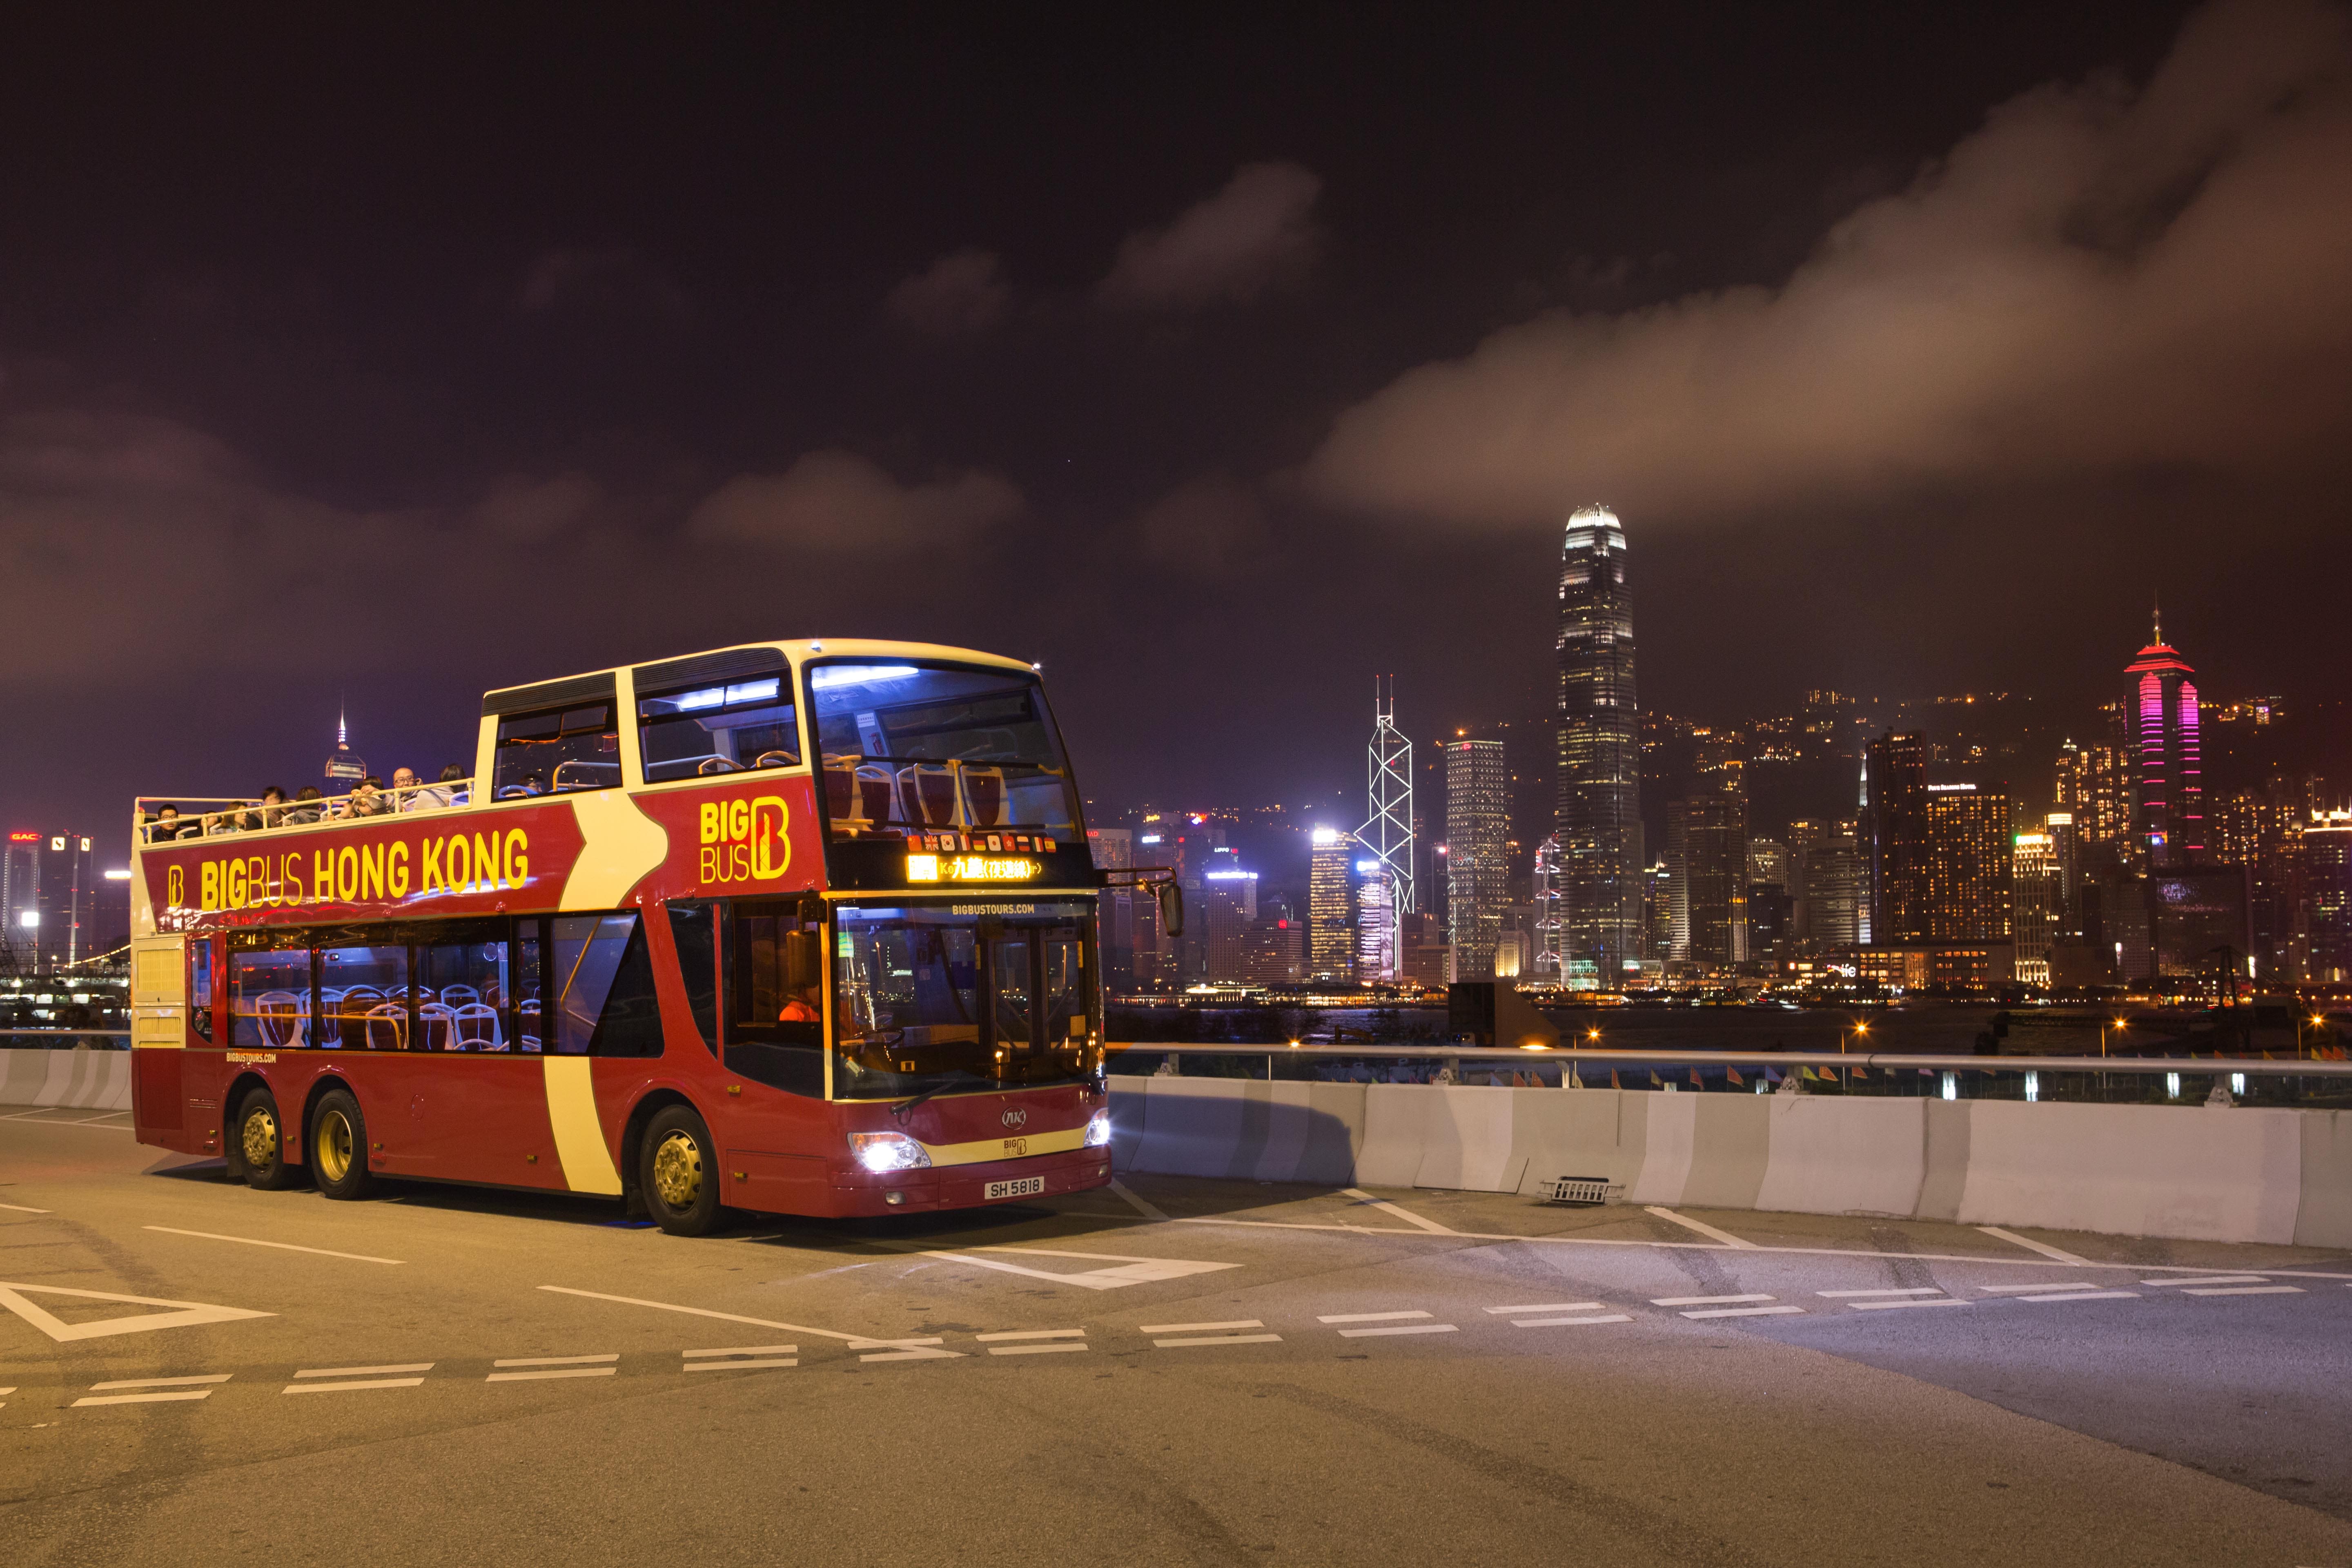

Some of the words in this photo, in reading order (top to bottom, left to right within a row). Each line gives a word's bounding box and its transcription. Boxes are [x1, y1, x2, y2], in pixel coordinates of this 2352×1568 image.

[701, 799, 749, 844] BIG
[315, 841, 409, 904] HONG
[423, 828, 528, 895] KONG
[701, 844, 749, 884] BUS
[952, 904, 1035, 915] BIGBUSTOURS.COM
[226, 1052, 276, 1063] BIGBUSTOURS.COM
[1004, 1139, 1017, 1149] BIG
[1004, 1148, 1017, 1158] BUS
[991, 1183, 1007, 1197] SH
[1011, 1179, 1040, 1194] 5818
